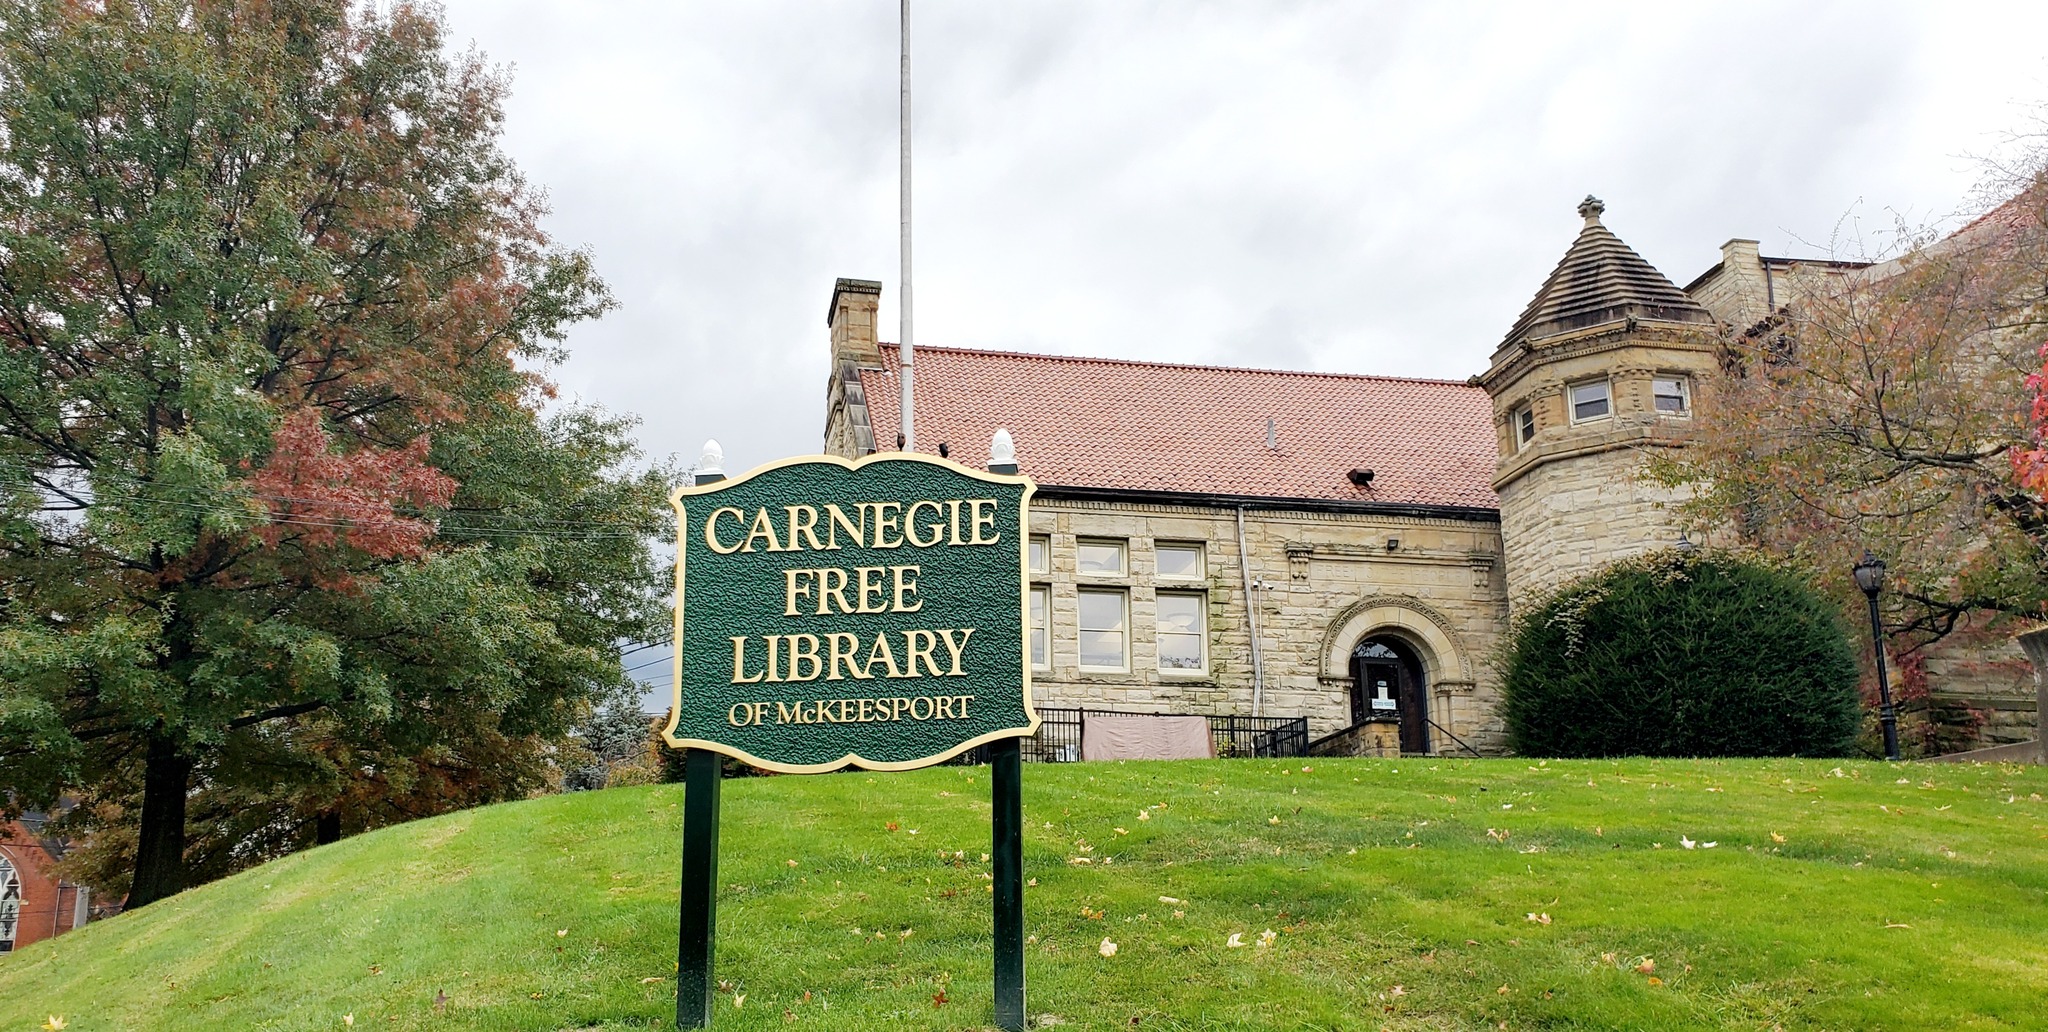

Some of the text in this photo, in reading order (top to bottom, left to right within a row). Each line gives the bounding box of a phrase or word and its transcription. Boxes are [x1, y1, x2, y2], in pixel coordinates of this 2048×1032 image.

[704, 499, 1000, 554] CARNEGIE
[783, 565, 923, 616] FREE
[730, 628, 976, 684] LIBRARY
[728, 695, 975, 727] OF McKEESPORT
